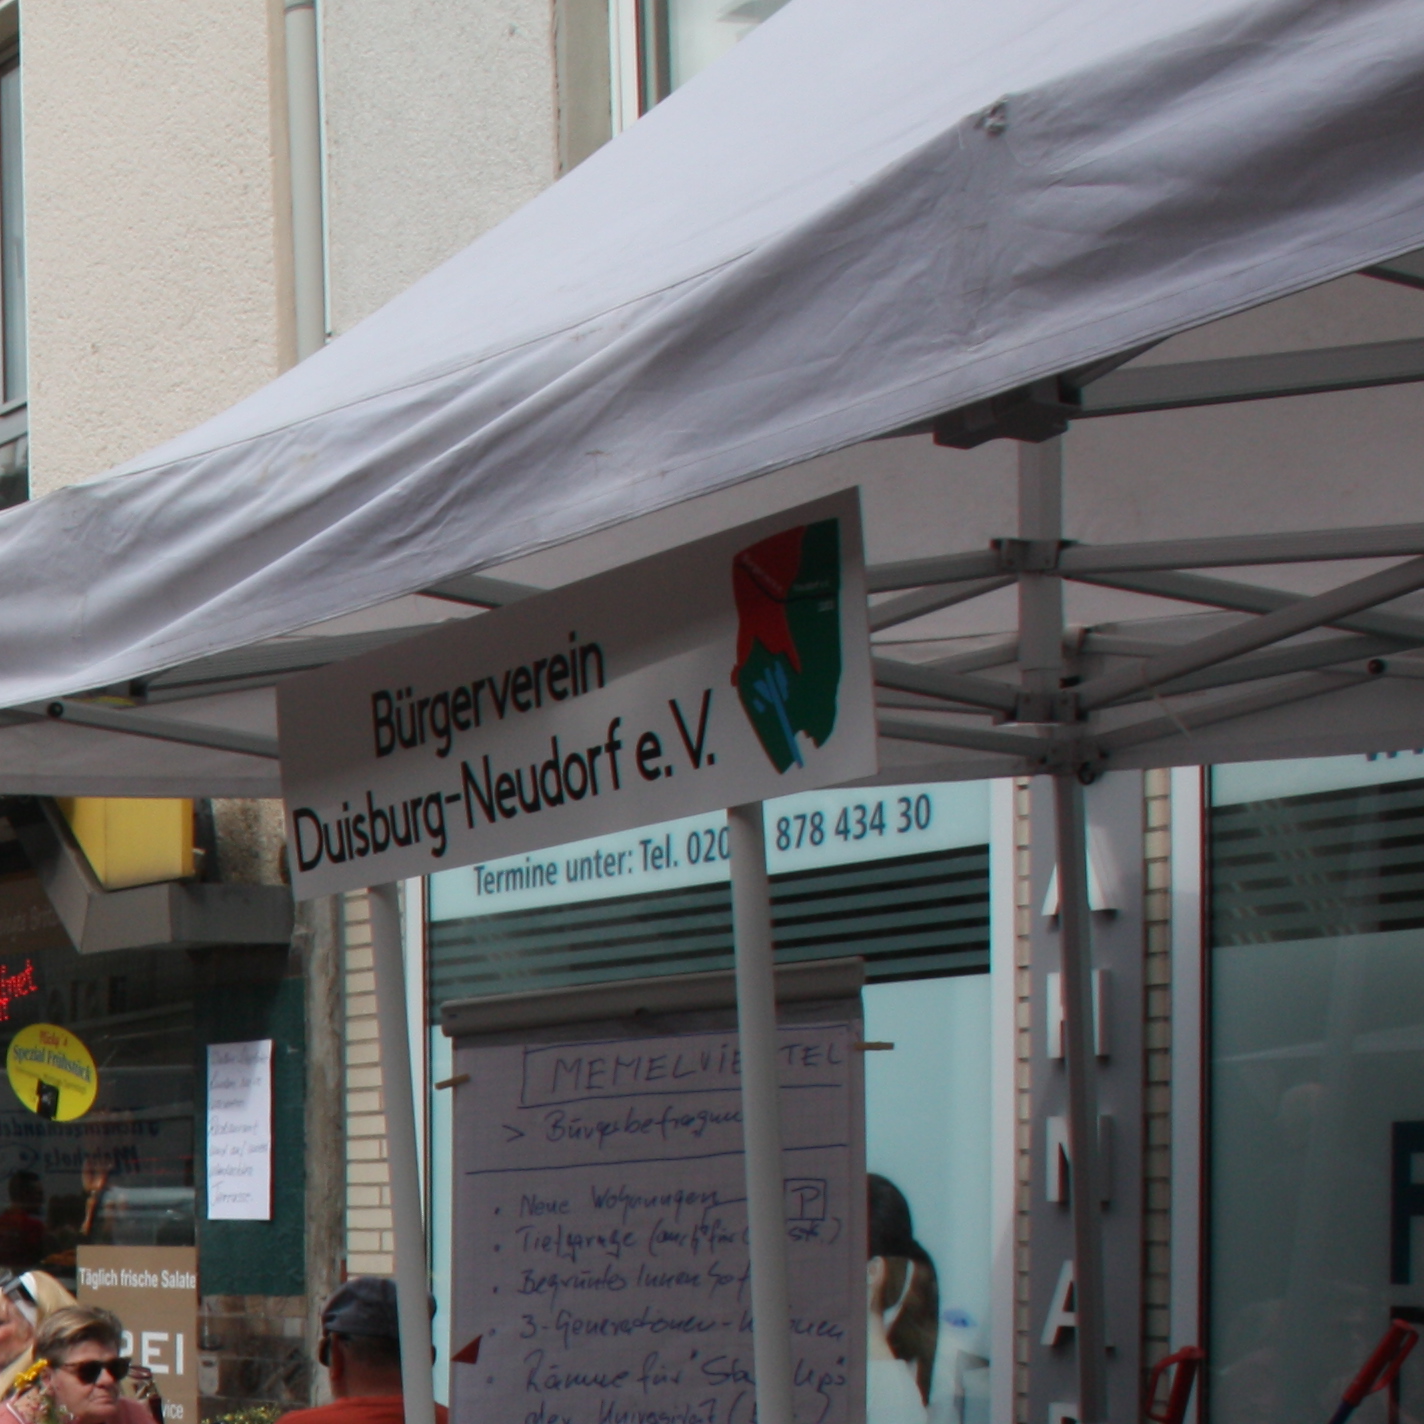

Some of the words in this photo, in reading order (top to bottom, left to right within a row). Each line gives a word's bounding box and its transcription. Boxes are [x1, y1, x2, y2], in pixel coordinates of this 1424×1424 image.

[372, 630, 605, 758] Bürgerverein
[293, 717, 623, 873] Duisburg-Neudorf
[474, 855, 558, 896] Termine
[566, 845, 632, 883] unter:
[640, 833, 678, 872] Tel.
[776, 811, 825, 850] 878
[835, 801, 886, 841] 434
[897, 793, 931, 832] 30
[79, 1267, 118, 1290] Täglich
[121, 1269, 158, 1288] frische
[161, 1270, 197, 1290] Salate
